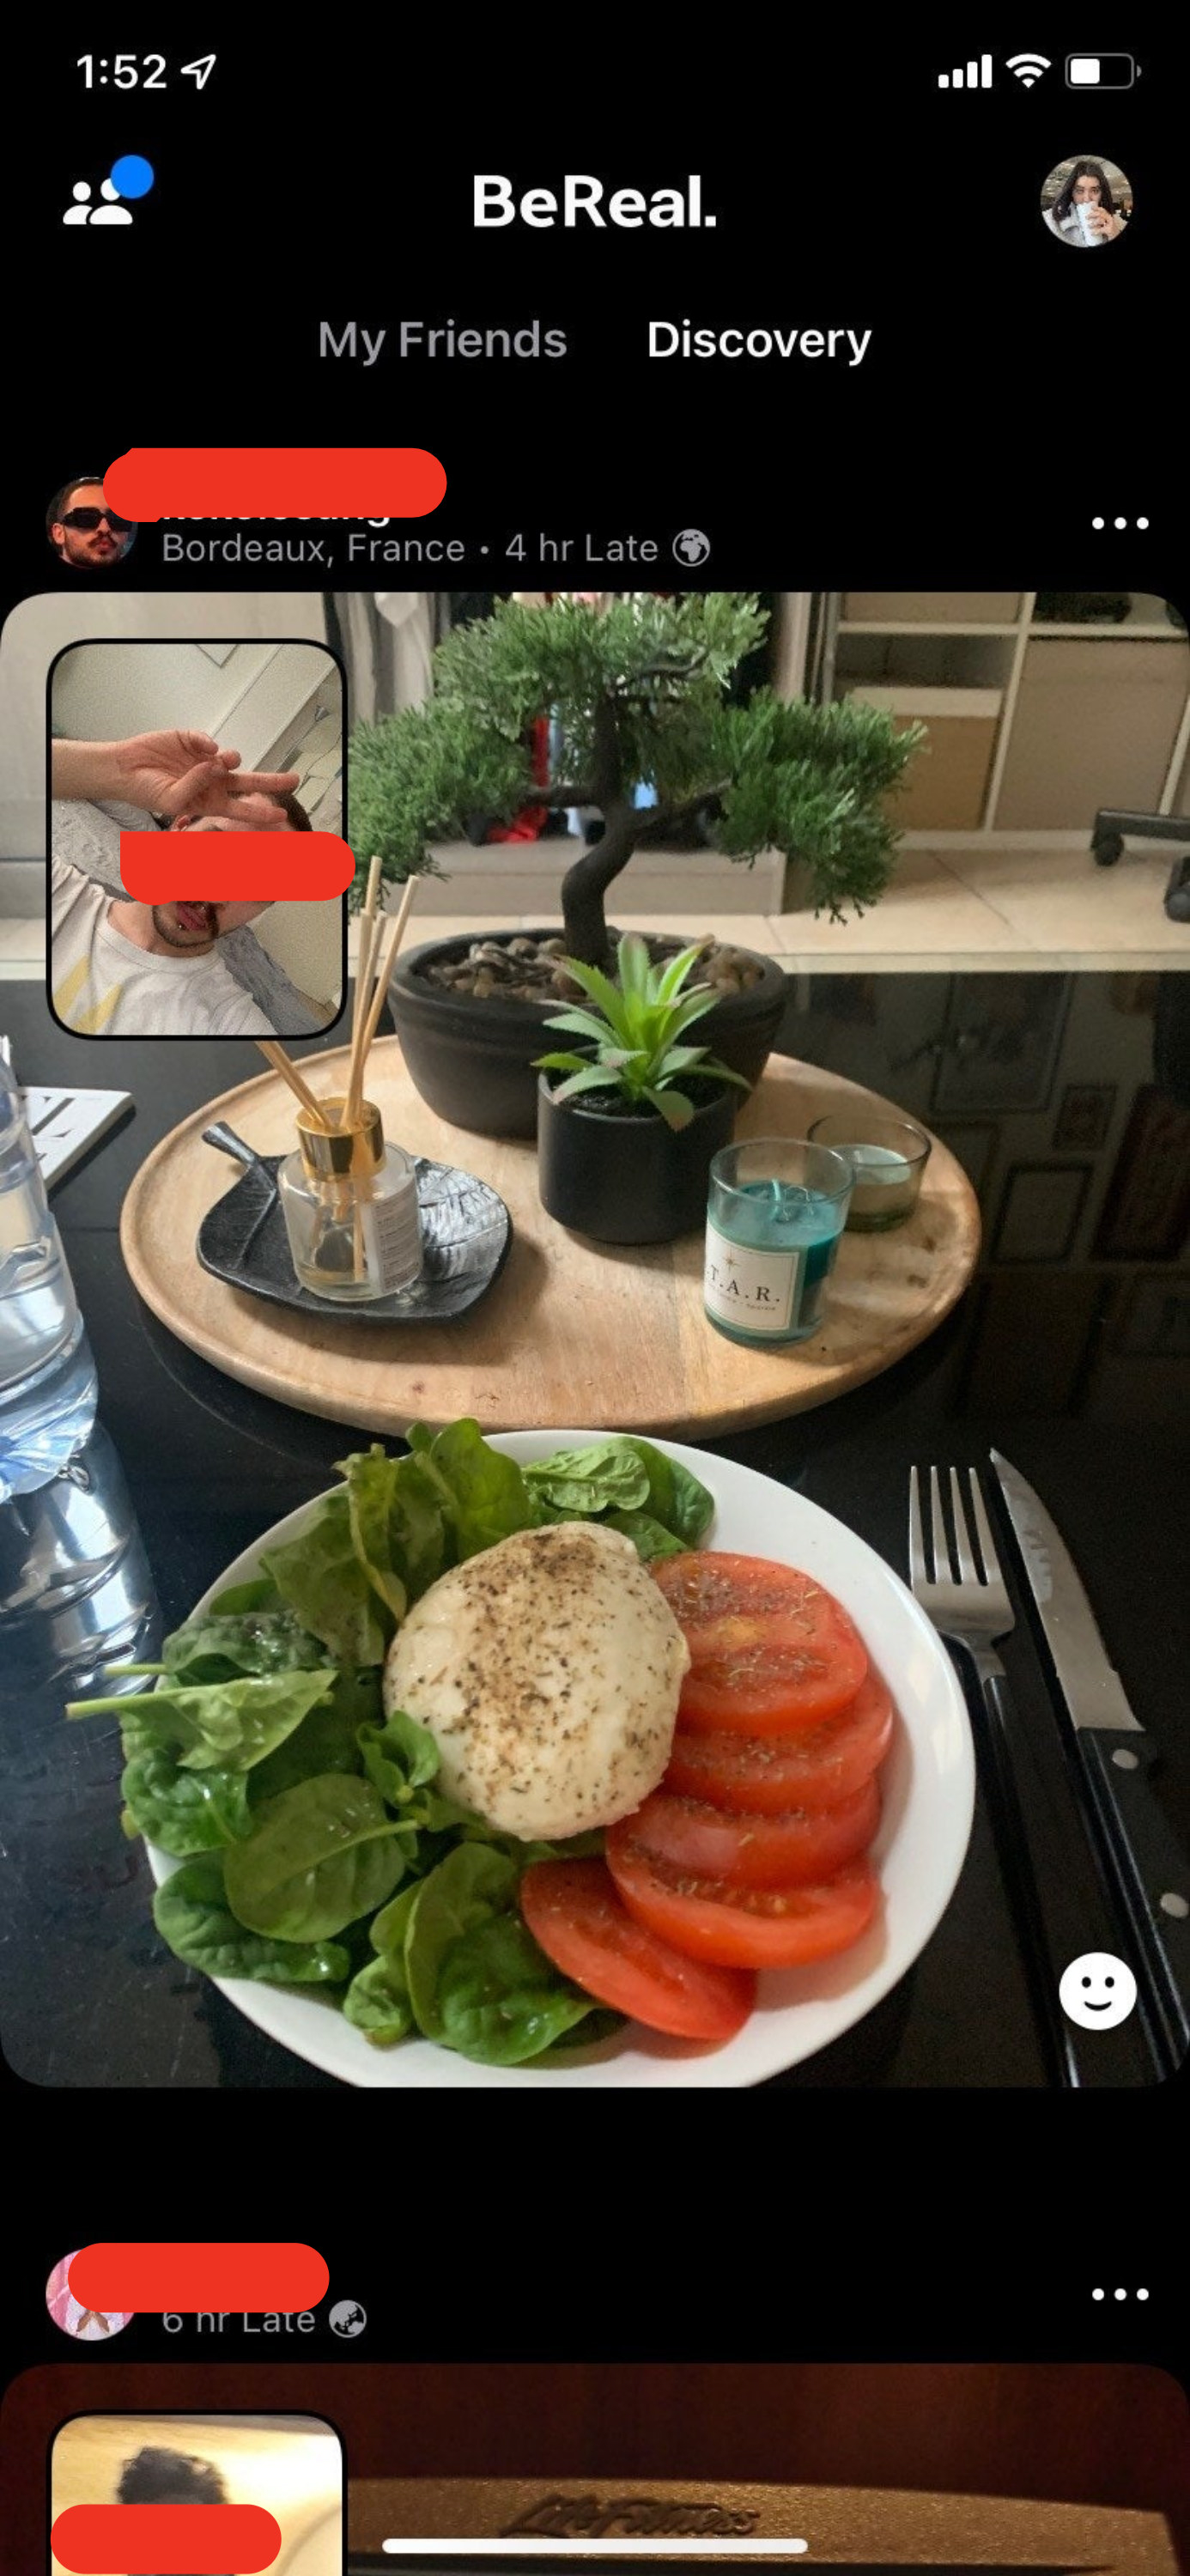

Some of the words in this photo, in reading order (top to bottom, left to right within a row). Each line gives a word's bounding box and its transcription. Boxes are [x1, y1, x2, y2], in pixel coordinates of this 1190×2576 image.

[76, 53, 167, 90] 1:52
[473, 174, 717, 228] BeReal.
[319, 321, 386, 367] My
[400, 318, 568, 358] Friends
[648, 318, 873, 368] Discovery
[163, 532, 333, 568] Bordeaux,
[349, 533, 465, 562] France
[505, 533, 527, 562] 4
[539, 532, 574, 562] hr
[586, 533, 659, 562] Late
[243, 2312, 316, 2333] Late
